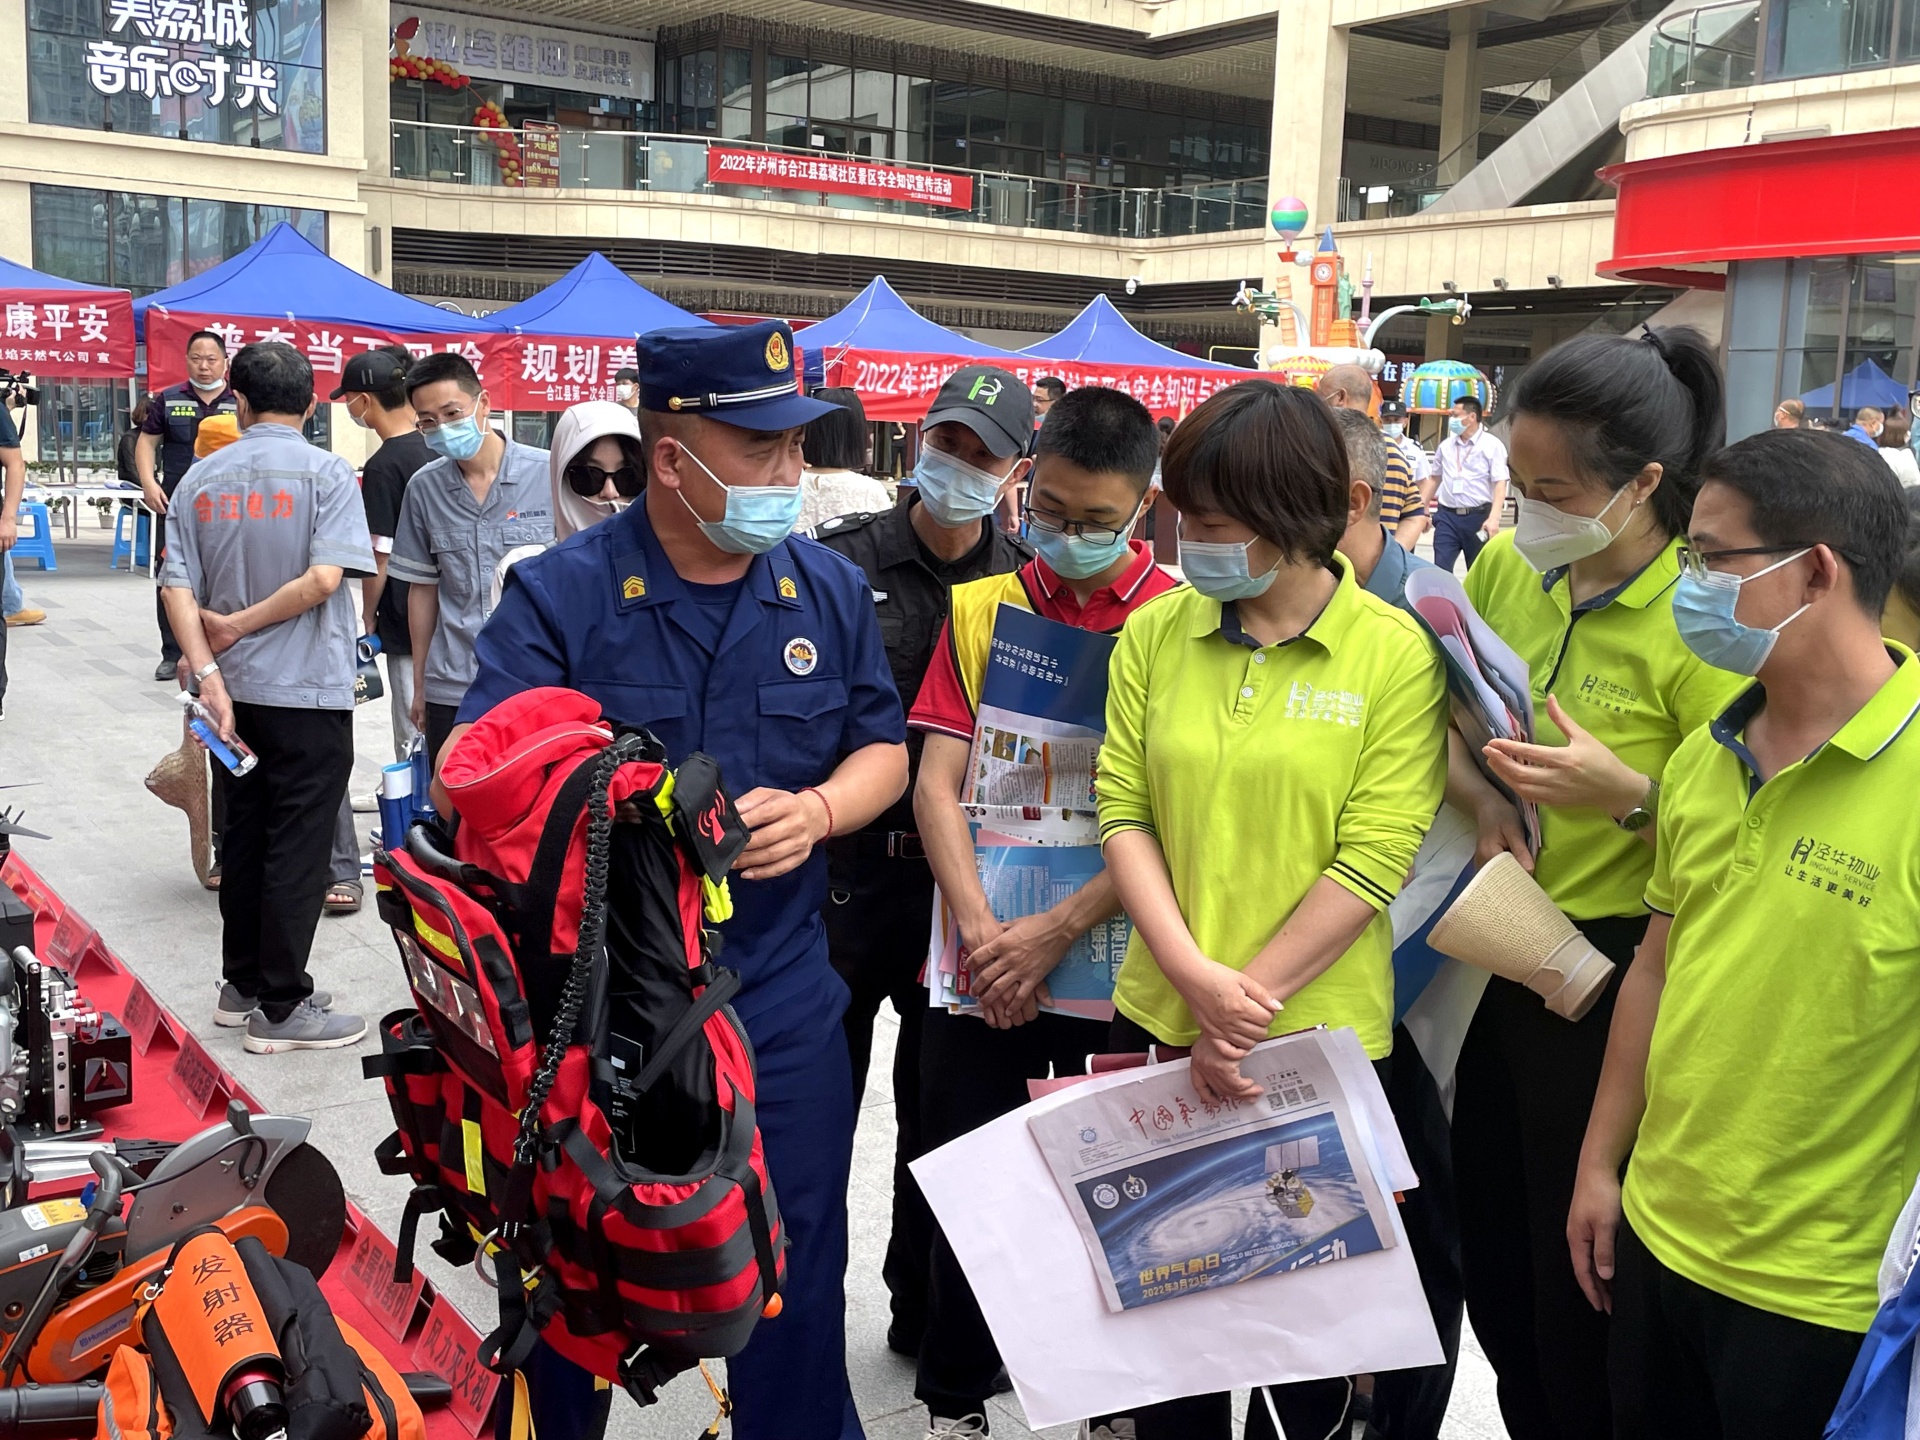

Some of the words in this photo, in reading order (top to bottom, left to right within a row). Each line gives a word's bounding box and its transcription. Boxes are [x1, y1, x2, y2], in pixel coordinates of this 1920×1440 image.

[720, 154, 952, 195] 2022年泸州市合江县荔城社区景区安全知识宣传活动
[5, 301, 109, 343] 康平安
[0, 348, 89, 363] 焰天然气公司
[194, 488, 294, 523] 合江电力
[1808, 860, 1839, 877] JINGHUA
[1843, 873, 1877, 892] SERVICE
[1814, 842, 1881, 881] 泾华物业
[1784, 864, 1872, 907] 让生活更美好
[1138, 1252, 1220, 1287] 世界气象日
[1221, 1252, 1244, 1264] WORLD
[190, 1253, 255, 1348] 发射器
[1142, 1273, 1210, 1299] 2022年3月23日
[425, 1316, 488, 1413] 风力灭火机
